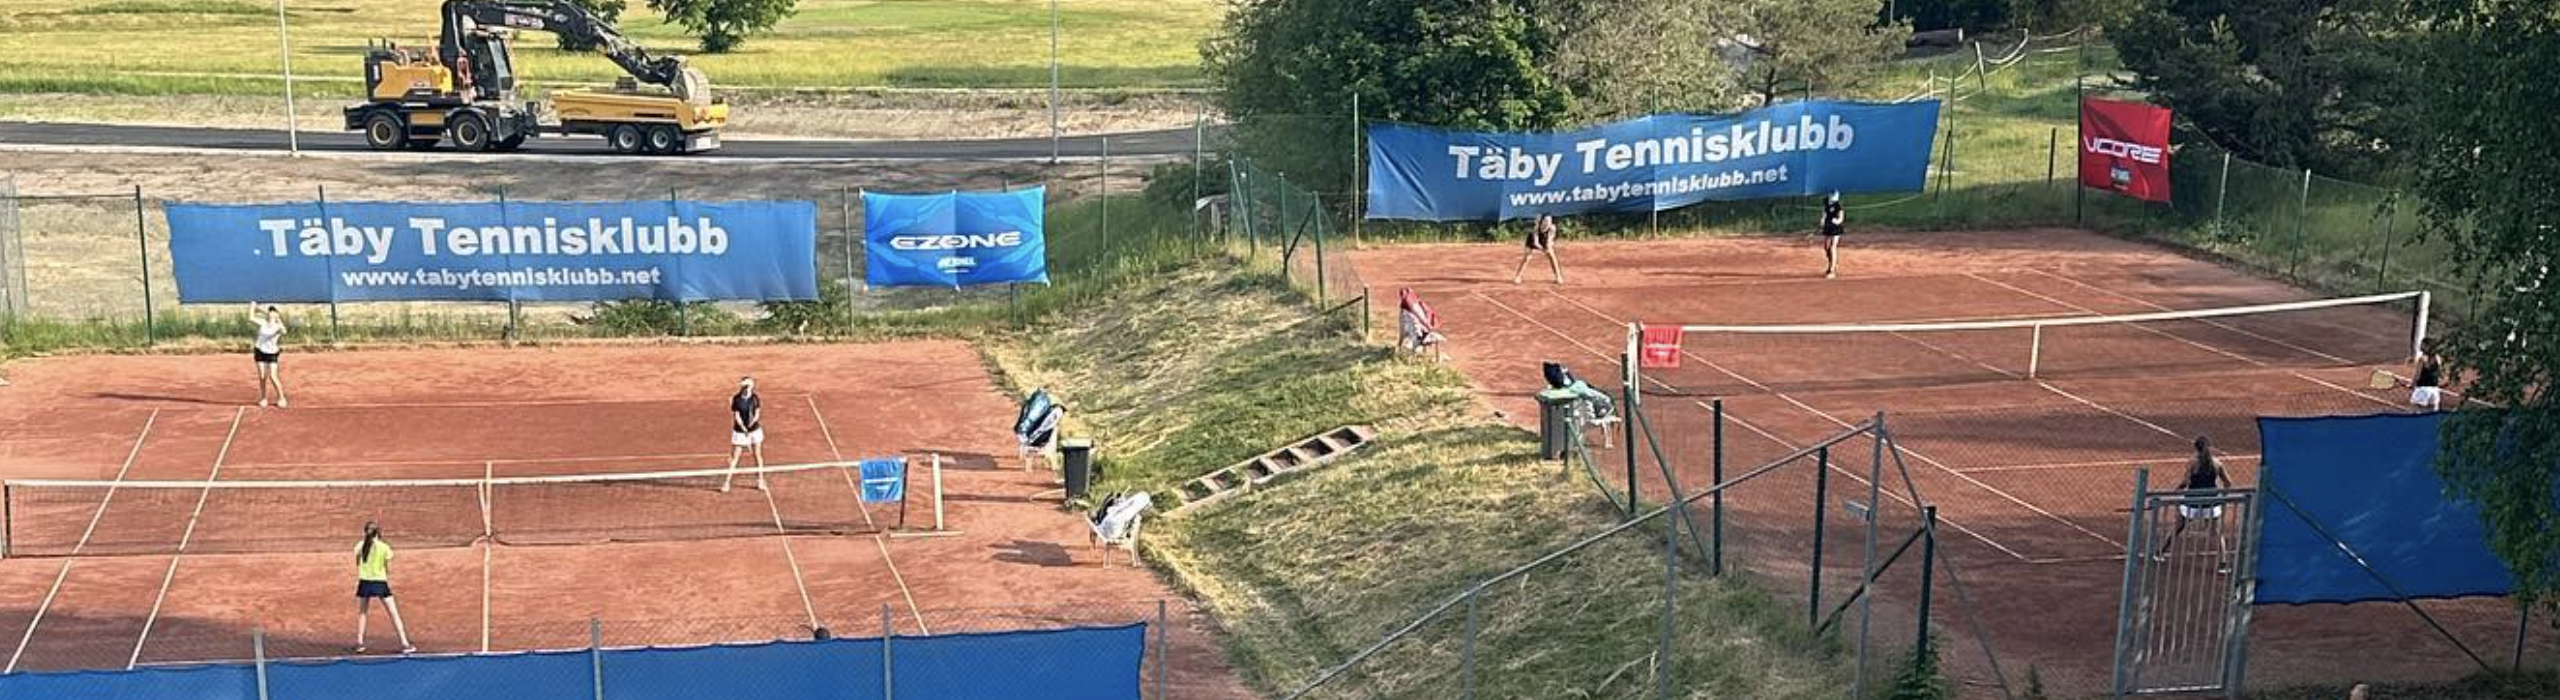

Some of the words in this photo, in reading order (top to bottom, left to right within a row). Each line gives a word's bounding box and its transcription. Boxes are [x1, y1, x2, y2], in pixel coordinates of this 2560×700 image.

[1448, 143, 1562, 186] Täby
[1576, 114, 1855, 174] Tennisklubb
[2083, 135, 2162, 164] VCORE
[1509, 162, 1789, 208] www.tabytennisklubb.net
[259, 216, 393, 263] Täby
[409, 216, 729, 258] Tennisklubb
[889, 231, 1022, 250] EZONE
[342, 267, 661, 290] www.tabytennisklubb.net
